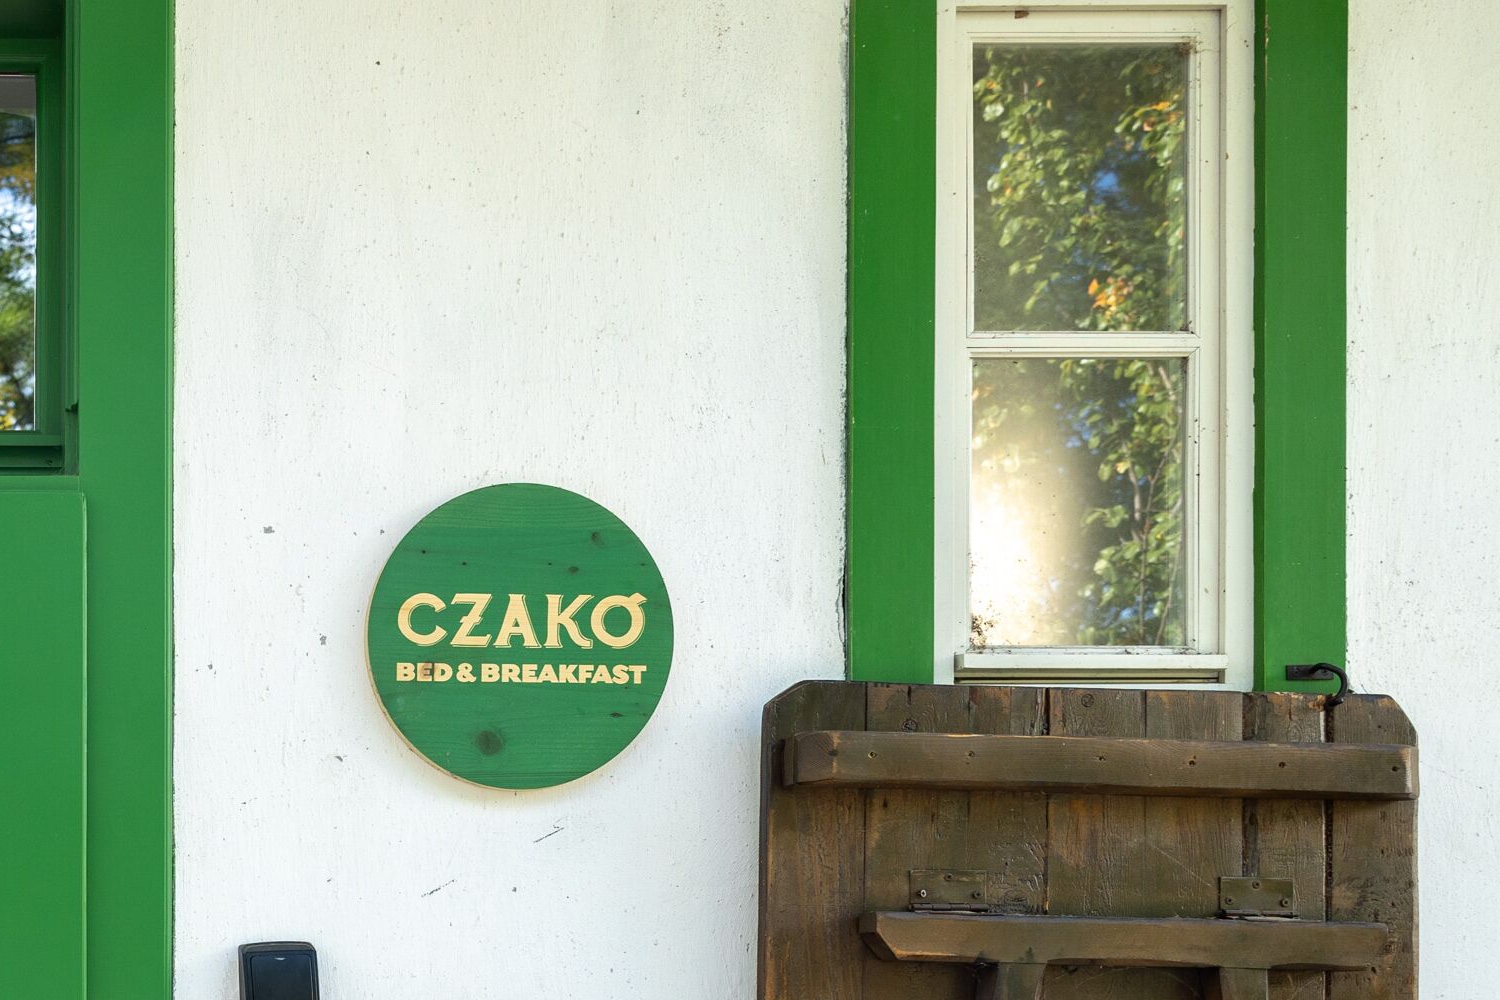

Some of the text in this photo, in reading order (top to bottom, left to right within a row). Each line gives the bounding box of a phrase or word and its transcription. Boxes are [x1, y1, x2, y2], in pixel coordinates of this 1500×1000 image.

[396, 662, 647, 684] BED & BREAKFAST
